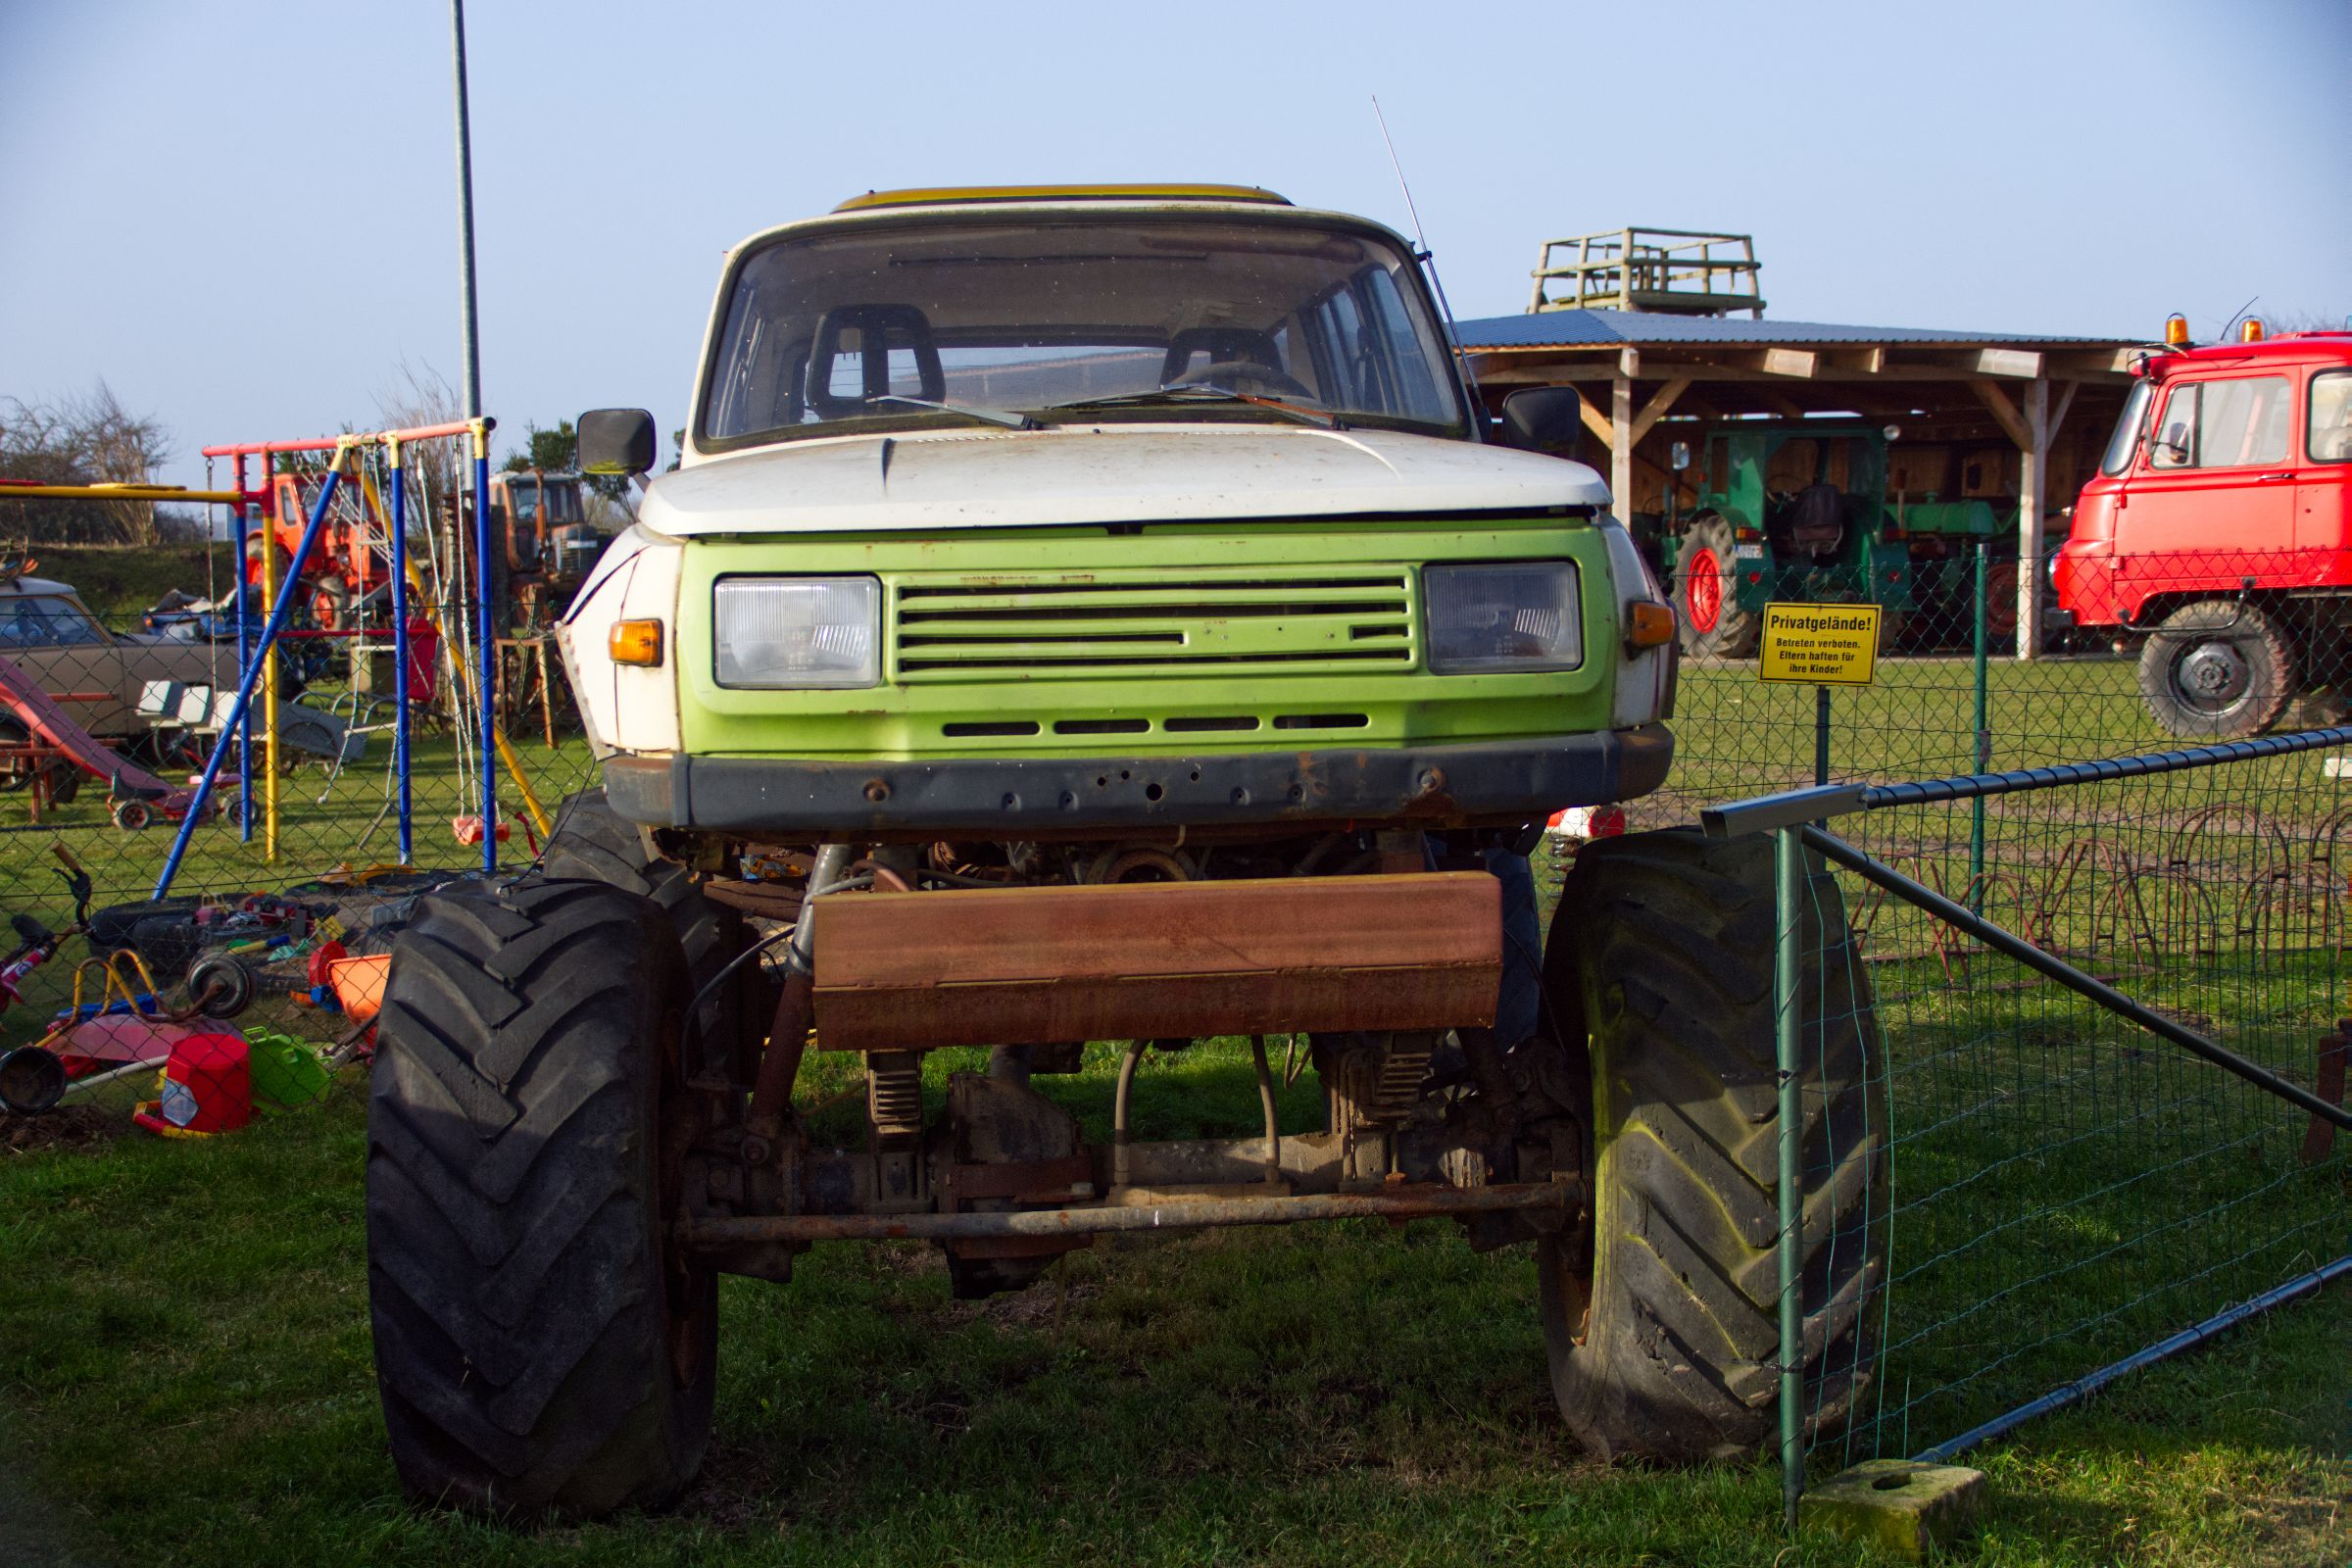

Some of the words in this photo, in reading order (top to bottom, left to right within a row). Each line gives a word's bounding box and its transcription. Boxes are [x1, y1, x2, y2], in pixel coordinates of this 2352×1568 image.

[1770, 614, 1872, 632] Privatgelände!
[1776, 638, 1815, 648] Betreten
[1818, 639, 1861, 649] verboten.
[1779, 651, 1806, 661] Eltern
[1808, 652, 1838, 662] haften
[1841, 653, 1855, 662] für
[1788, 664, 1807, 673] ihre
[1809, 664, 1842, 674] Kinder!
